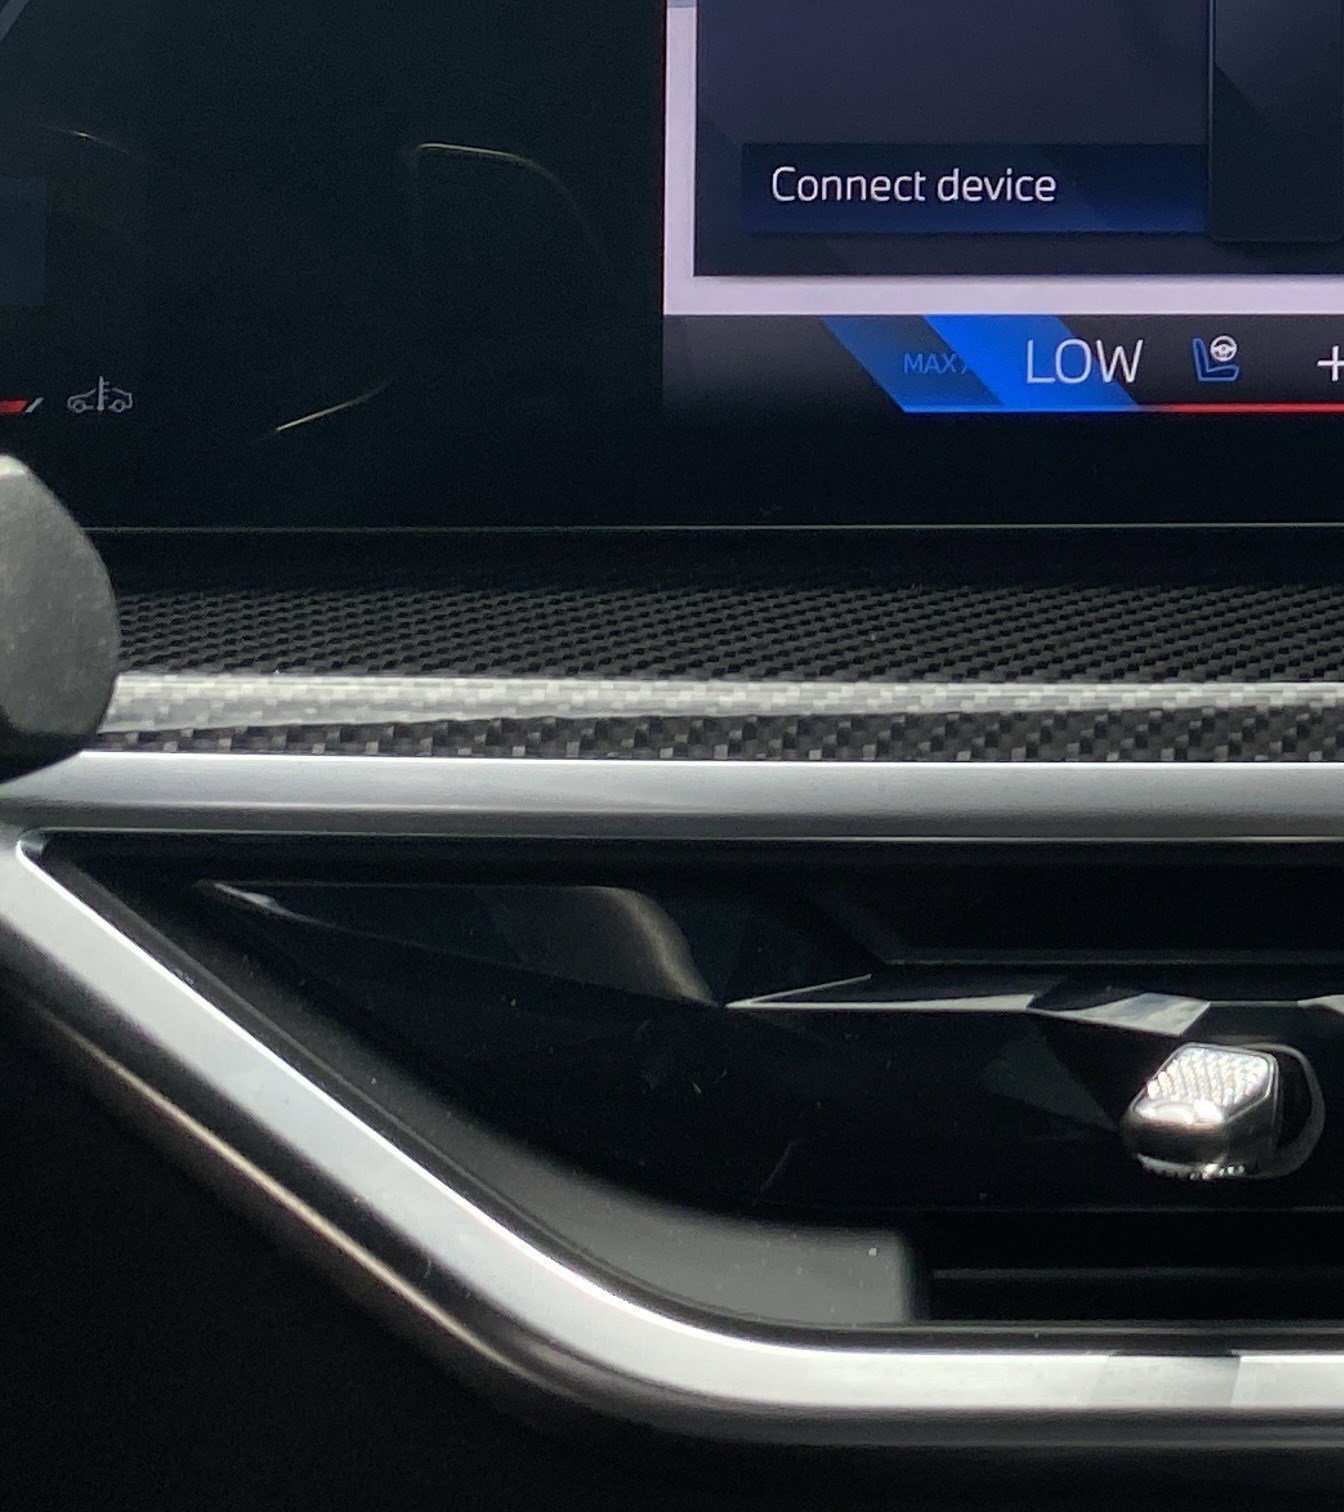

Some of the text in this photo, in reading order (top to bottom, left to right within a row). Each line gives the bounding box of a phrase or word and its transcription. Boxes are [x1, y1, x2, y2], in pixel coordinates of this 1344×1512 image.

[770, 165, 1058, 203] Connect device
[1026, 338, 1145, 385] LOW
